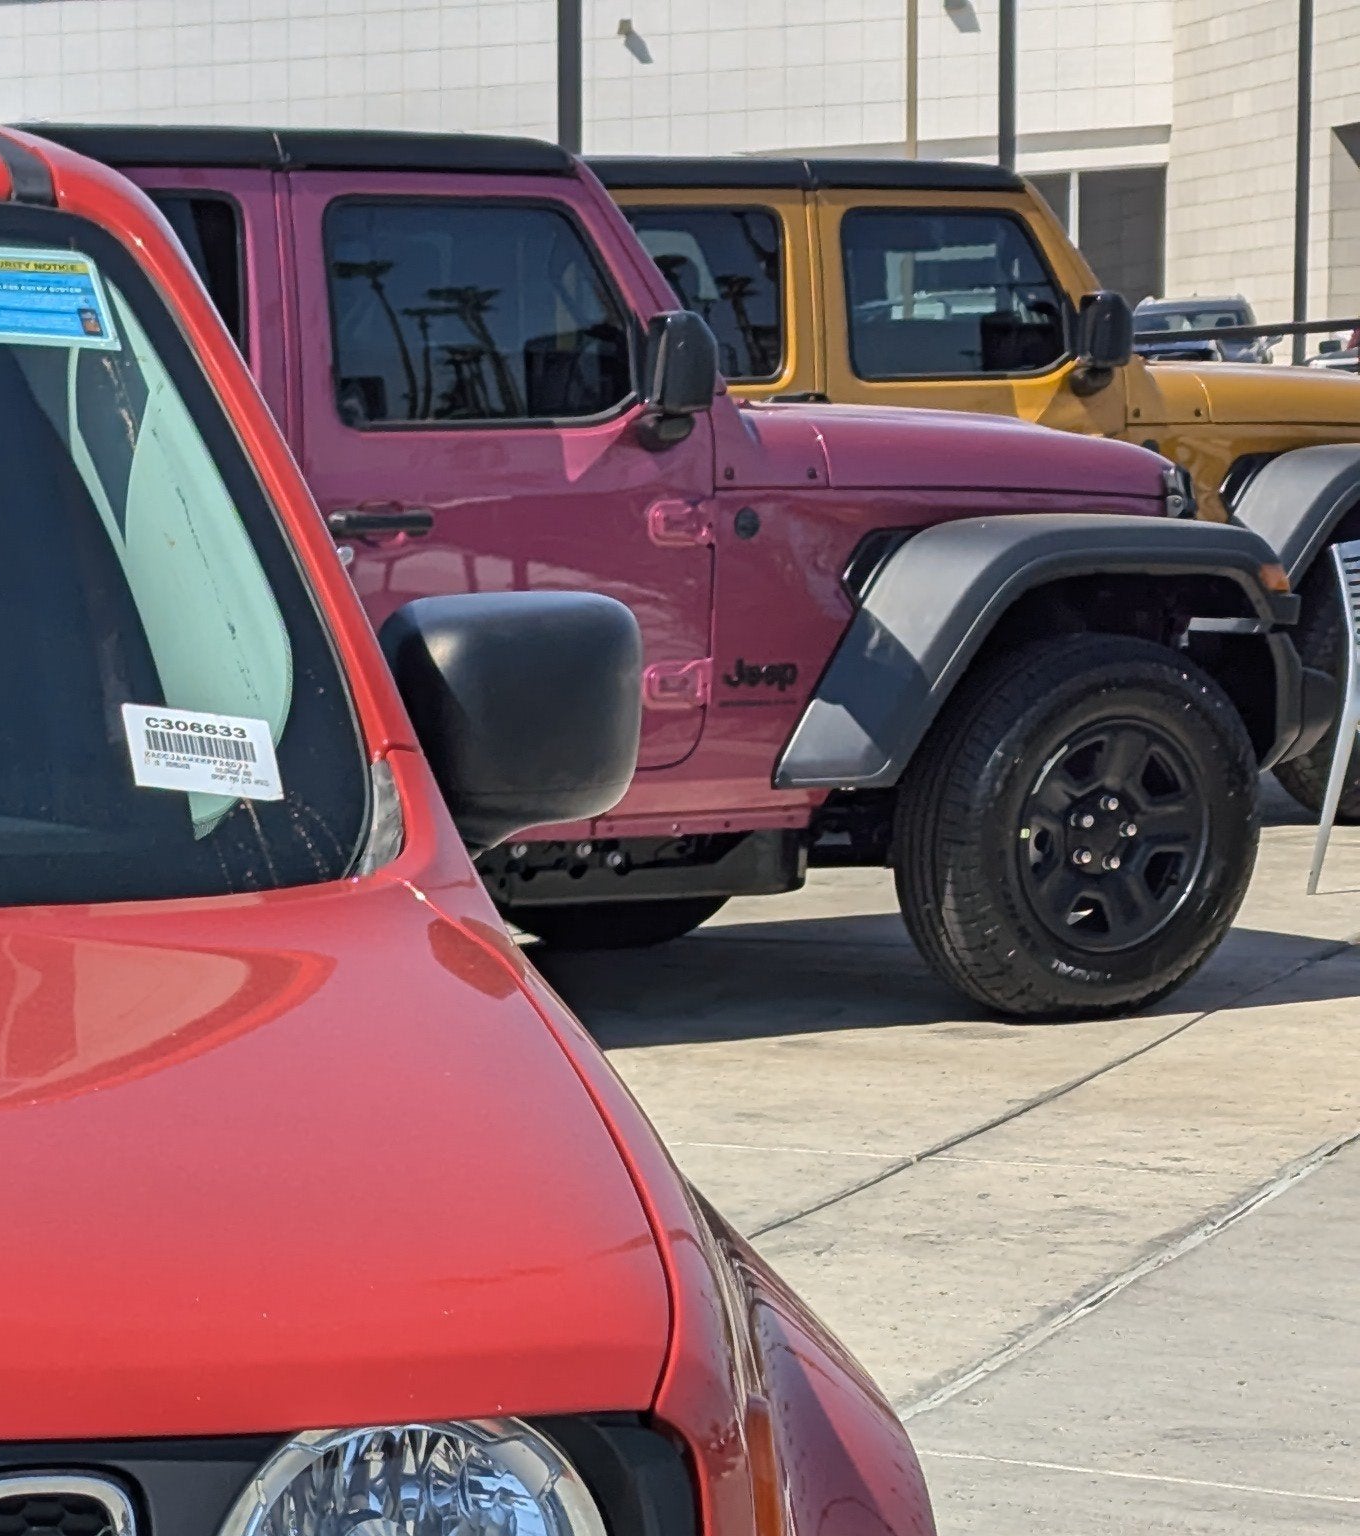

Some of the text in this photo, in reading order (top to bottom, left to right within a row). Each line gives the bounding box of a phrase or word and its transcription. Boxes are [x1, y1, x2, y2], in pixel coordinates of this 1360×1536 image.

[34, 262, 79, 273] NOTICE
[722, 656, 799, 692] Jeep
[145, 716, 247, 739] C306633
